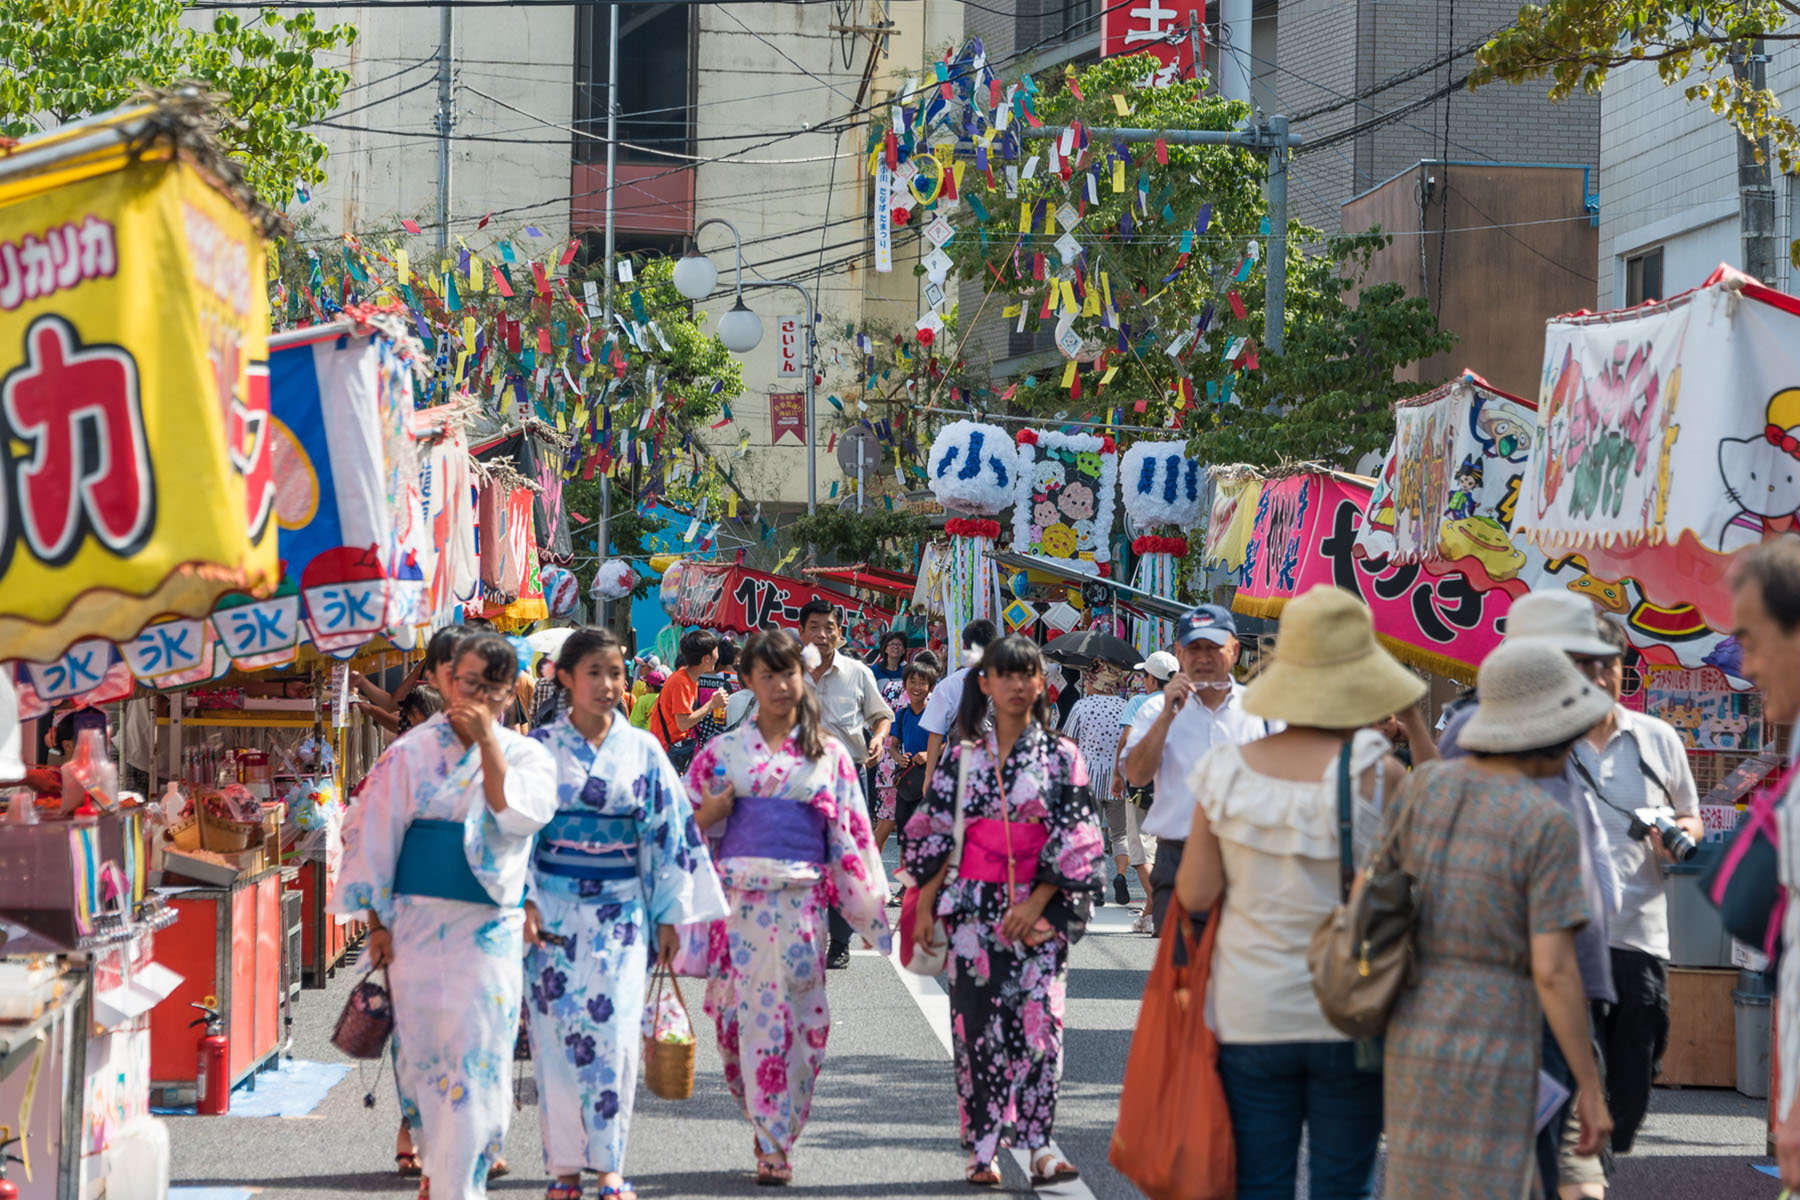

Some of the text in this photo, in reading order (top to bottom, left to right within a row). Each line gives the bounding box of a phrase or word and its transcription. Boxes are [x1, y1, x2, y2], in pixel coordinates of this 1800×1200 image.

[781, 320, 796, 373] さいしん
[230, 608, 287, 651] 氷
[322, 589, 376, 628] 氷
[138, 628, 194, 673] 氷
